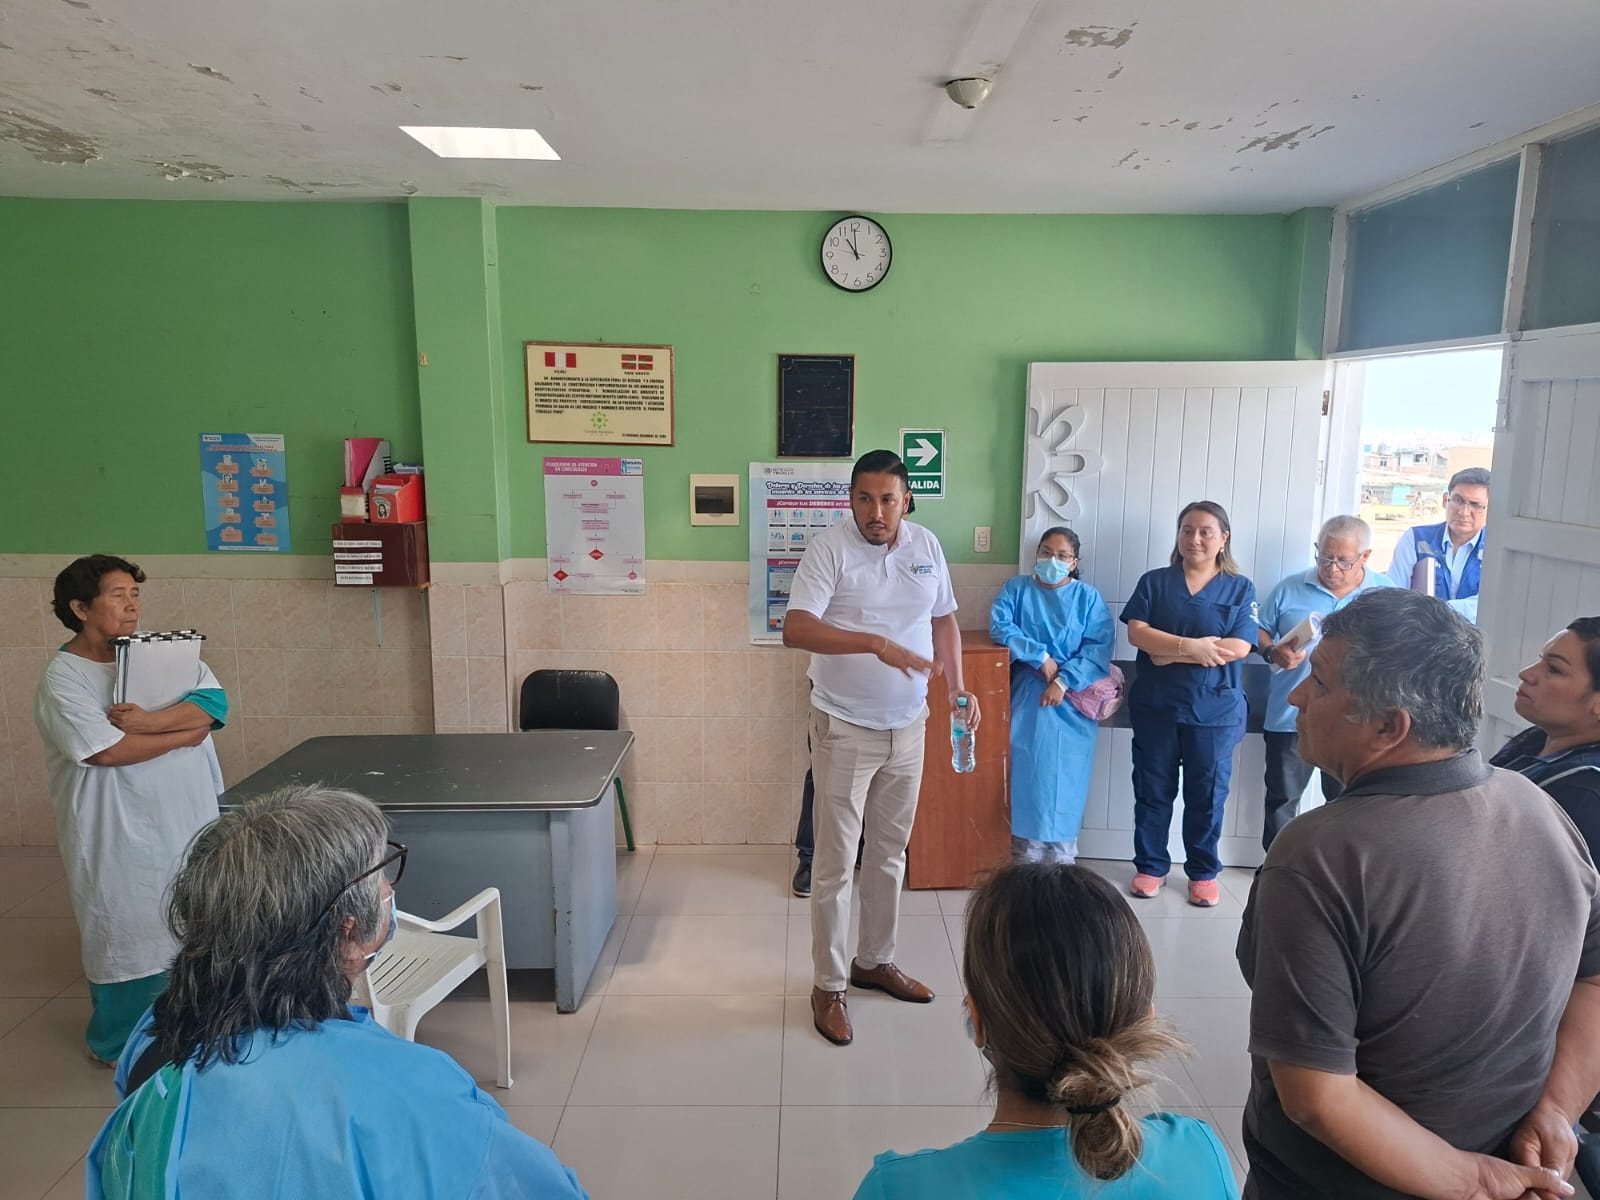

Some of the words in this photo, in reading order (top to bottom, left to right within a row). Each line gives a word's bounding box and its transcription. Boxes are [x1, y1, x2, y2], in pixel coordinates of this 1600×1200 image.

[839, 226, 846, 236] 11
[851, 222, 860, 232] 12
[830, 237, 839, 247] 10
[876, 235, 882, 244] 2
[826, 251, 834, 260] 9
[880, 248, 887, 258] 3
[831, 265, 839, 274] 8
[875, 262, 882, 271] 4
[841, 274, 848, 282] 7
[854, 277, 862, 286] 6
[866, 273, 874, 282] 5
